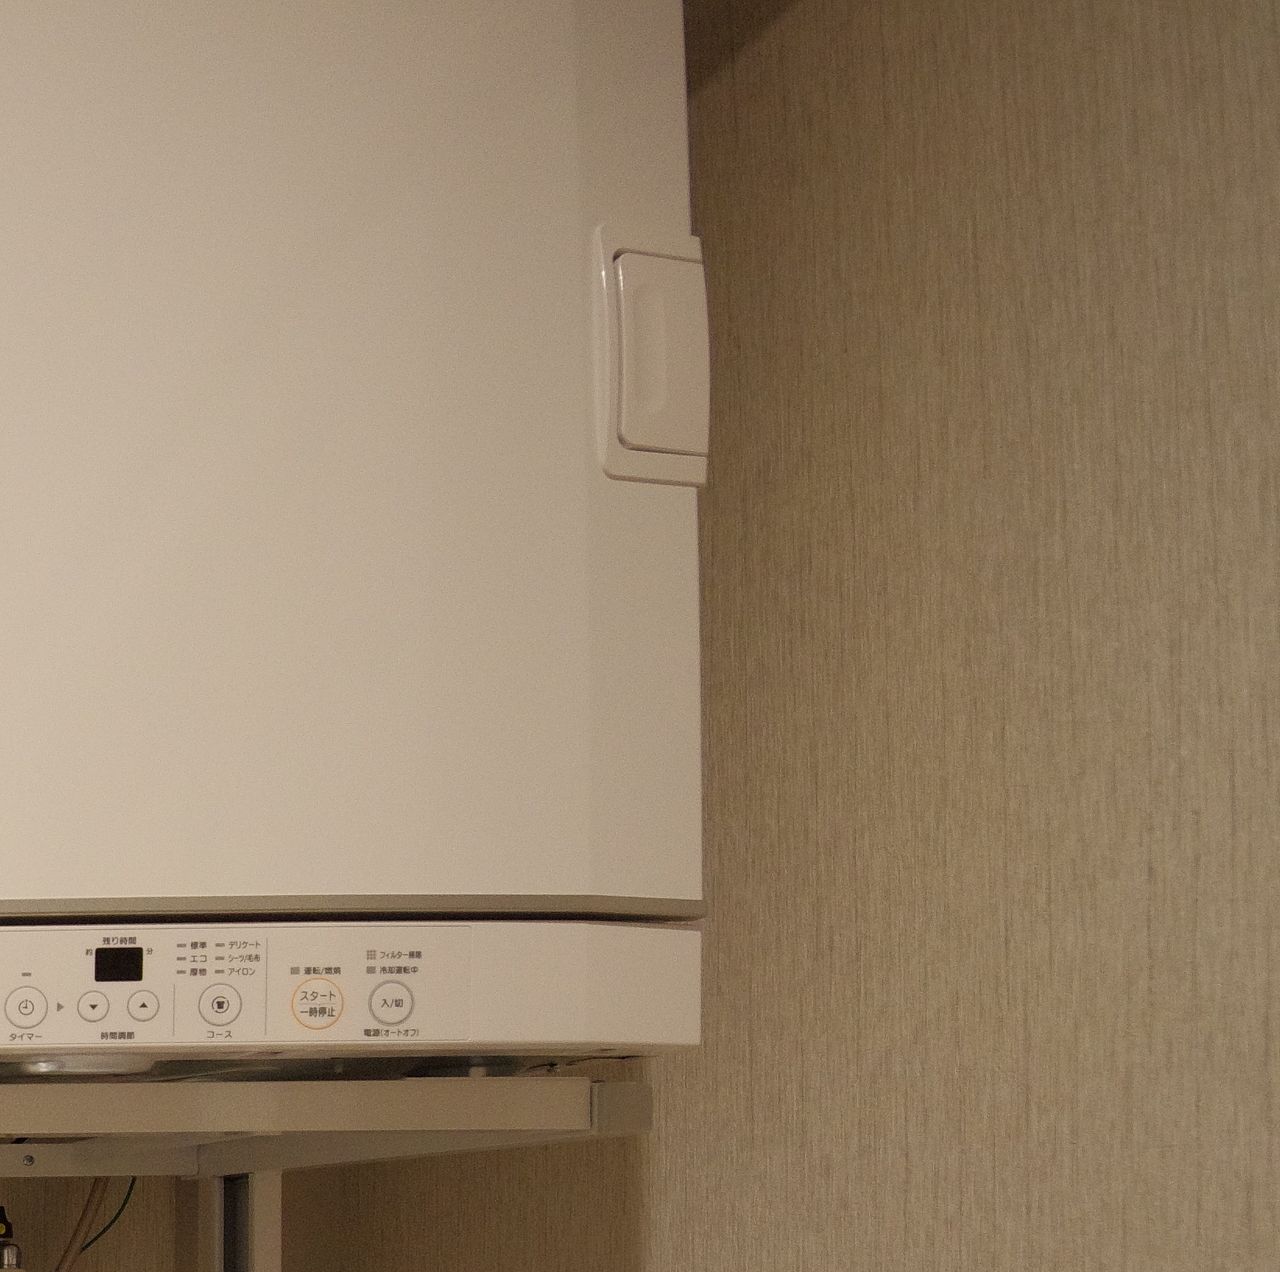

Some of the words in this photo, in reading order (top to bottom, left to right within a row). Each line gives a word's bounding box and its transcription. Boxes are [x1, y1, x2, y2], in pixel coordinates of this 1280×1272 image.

[102, 936, 138, 946] 残り時間
[190, 941, 208, 950] 標準
[228, 940, 261, 949] デリケート
[190, 954, 207, 963] エコ
[227, 953, 261, 963] シーツ/毛布
[228, 967, 256, 976] アイロン
[299, 990, 337, 1001] スタート
[380, 998, 404, 1008] 入/切
[299, 1007, 337, 1018] 一時停止
[9, 1032, 43, 1041] タイマー
[100, 1031, 136, 1040] 時間調節
[206, 1030, 233, 1039] コース
[363, 1028, 420, 1038] 電源(オートオフ)
